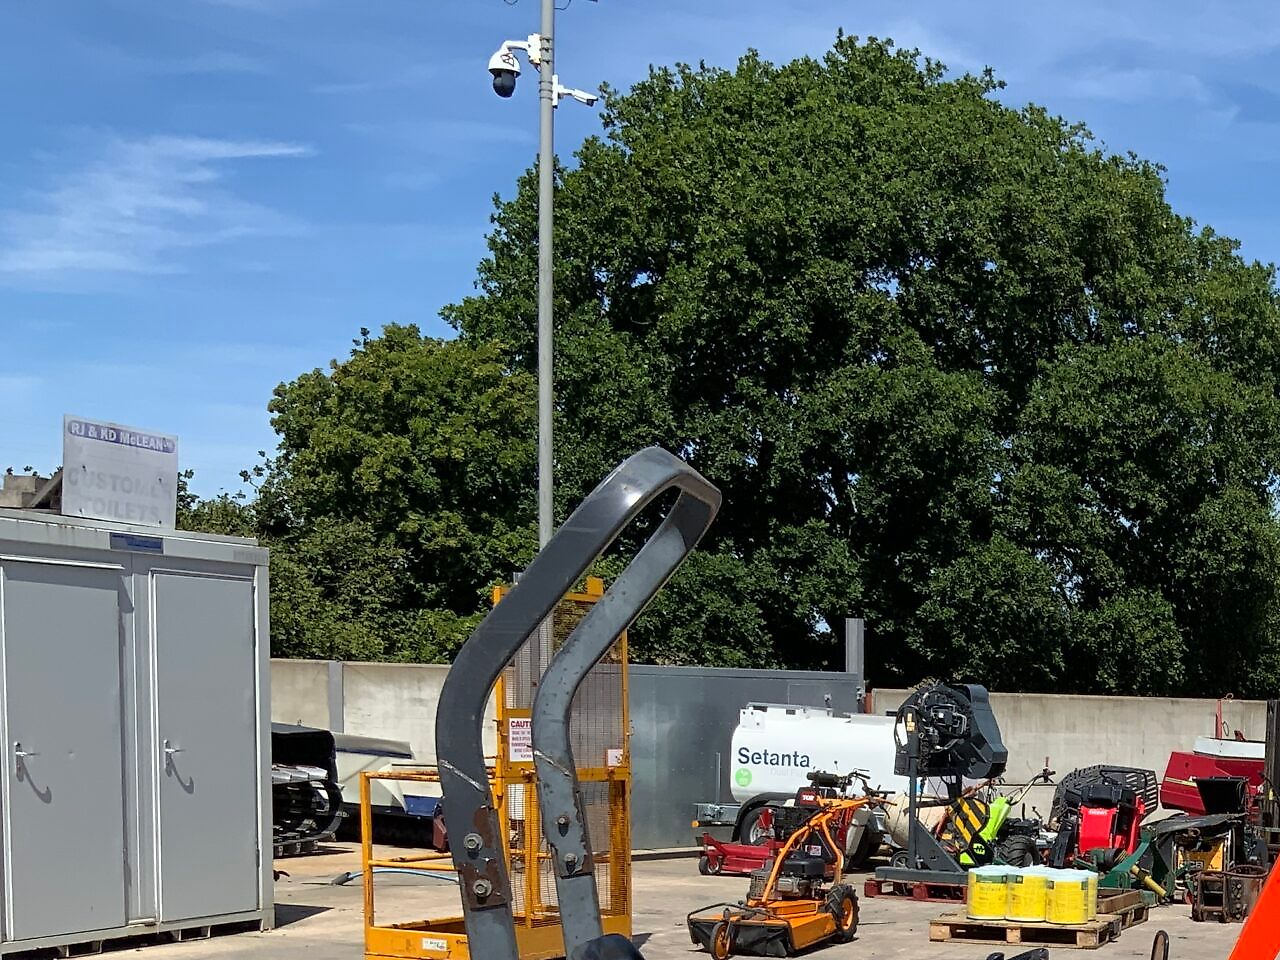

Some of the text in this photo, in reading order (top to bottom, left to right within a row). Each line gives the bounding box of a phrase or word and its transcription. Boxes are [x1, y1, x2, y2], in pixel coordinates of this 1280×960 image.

[71, 422, 85, 436] RJ
[88, 425, 97, 437] &
[737, 747, 810, 768] Setanta
